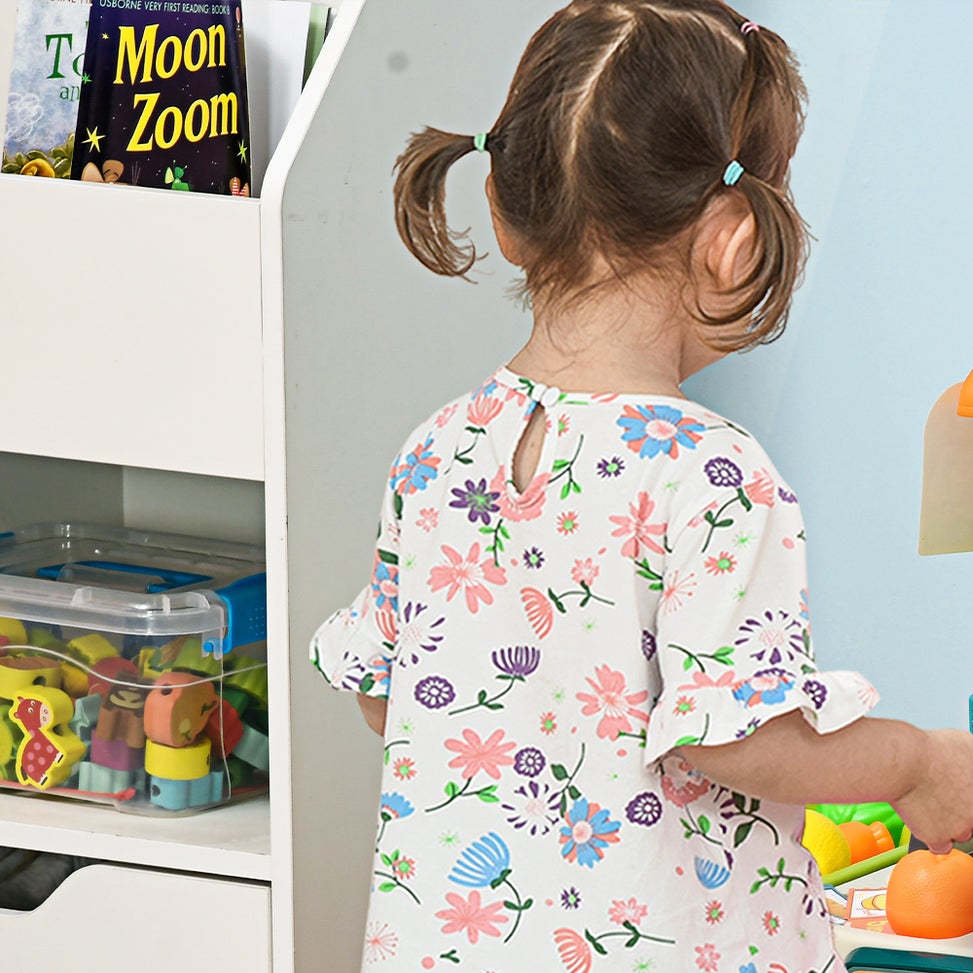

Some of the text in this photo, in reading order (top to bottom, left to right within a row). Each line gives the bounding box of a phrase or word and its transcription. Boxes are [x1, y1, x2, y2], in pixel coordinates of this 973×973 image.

[100, 0, 141, 10] OSBORNE
[144, 2, 161, 11] VERY
[164, 3, 180, 12] FIRST
[113, 24, 226, 86] Moon
[126, 92, 238, 151] Zoom
